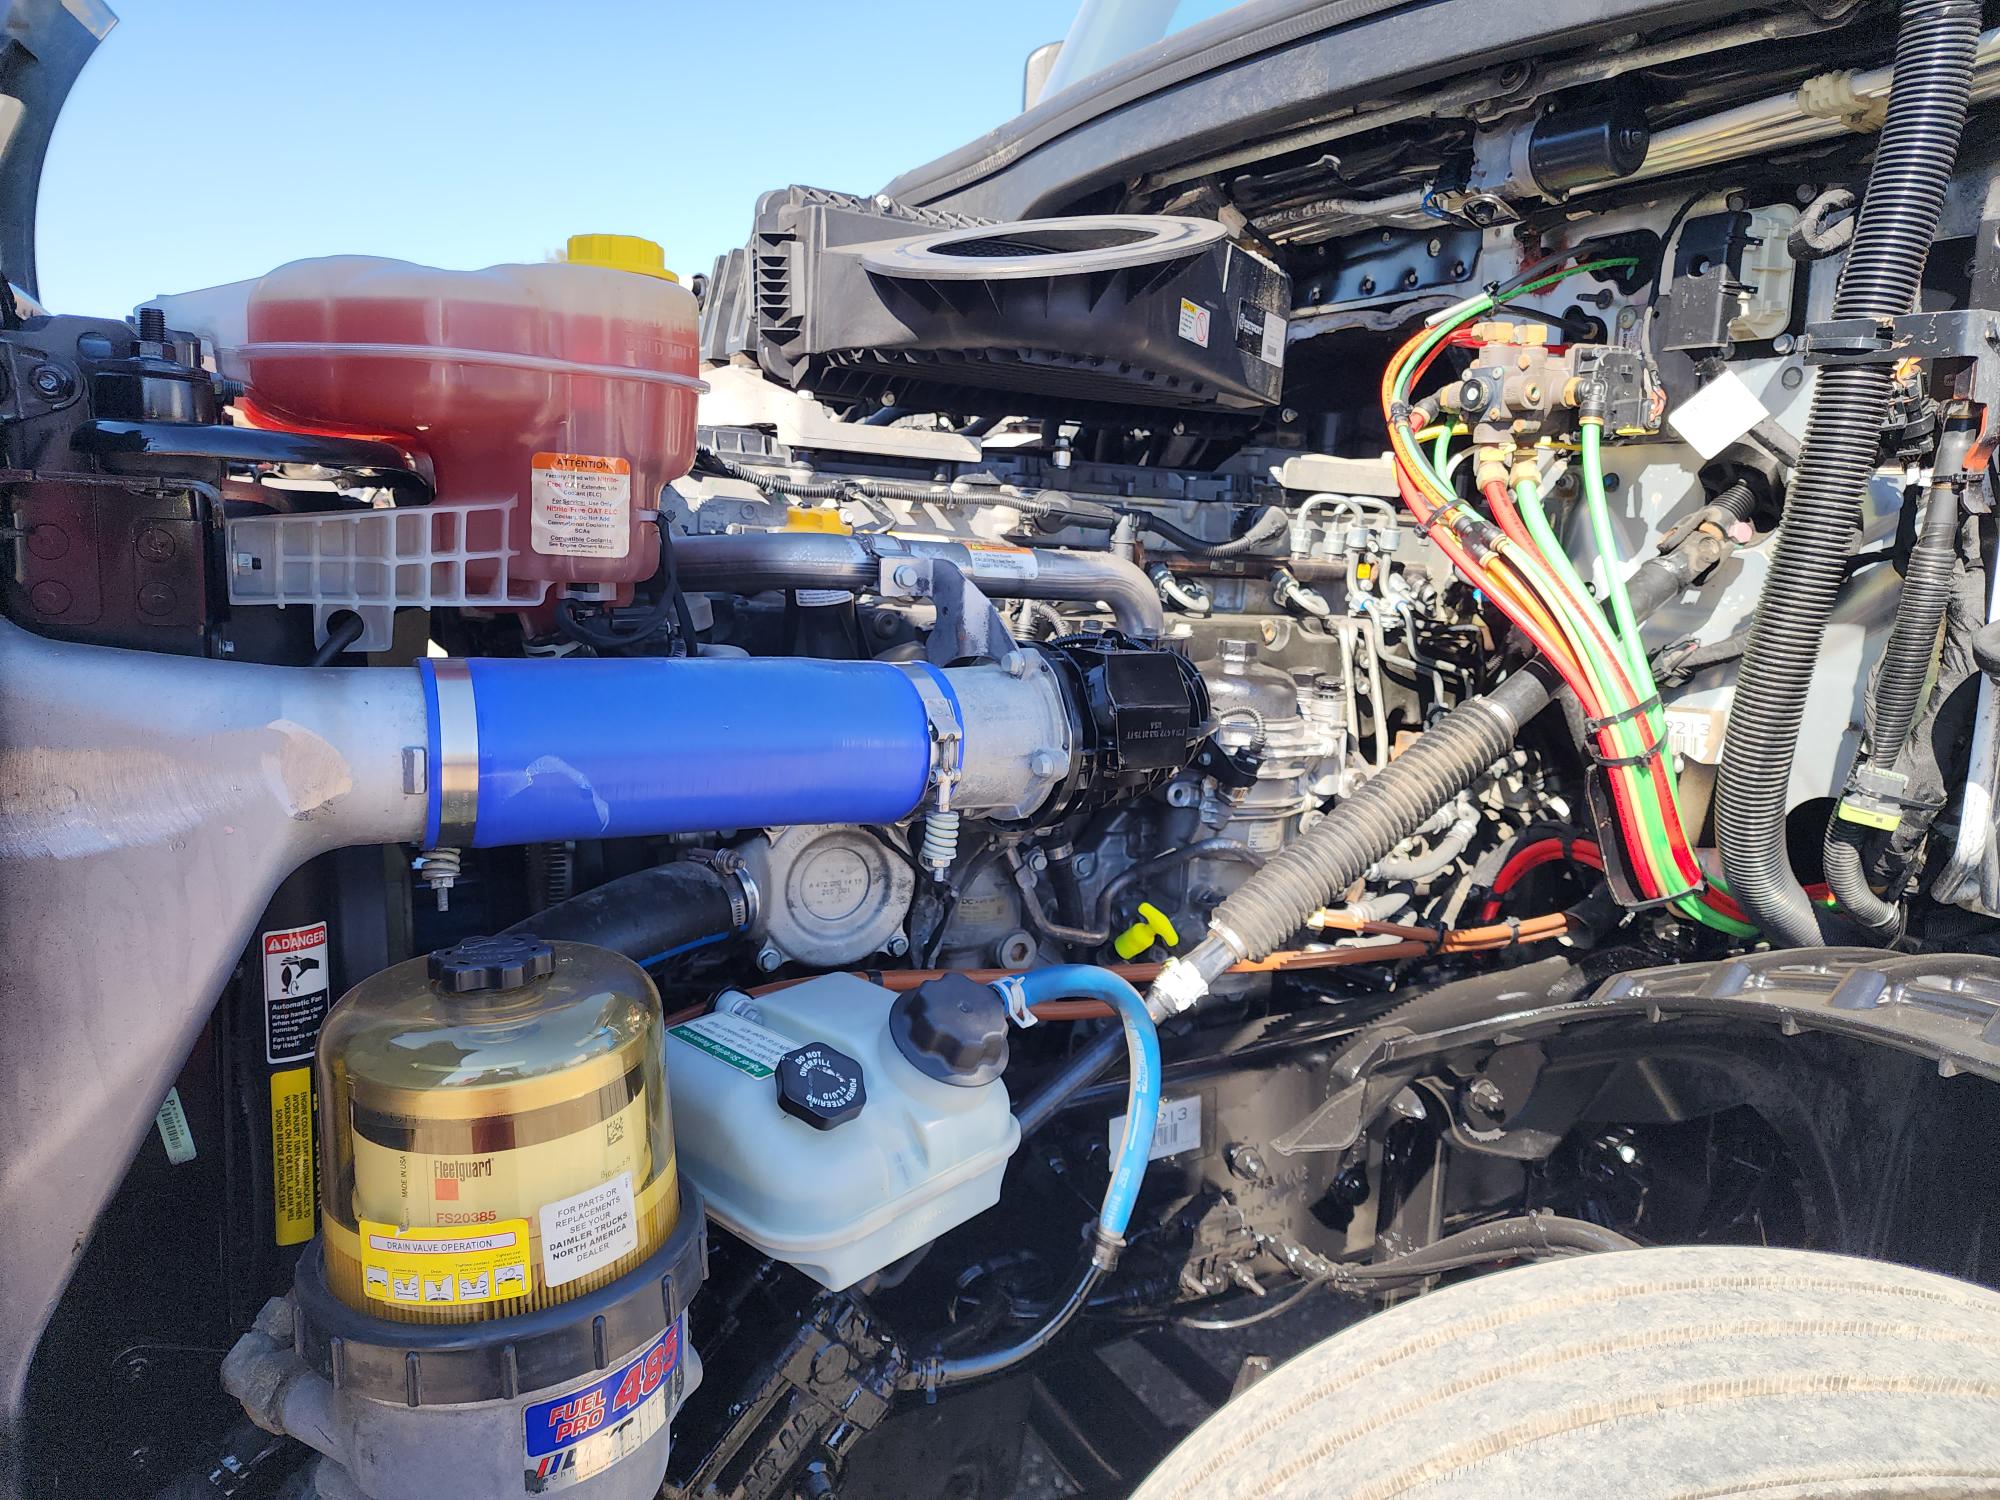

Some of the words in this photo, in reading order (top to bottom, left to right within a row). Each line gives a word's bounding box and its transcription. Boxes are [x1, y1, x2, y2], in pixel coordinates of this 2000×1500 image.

[557, 459, 609, 469] ATTENTION
[282, 930, 325, 950] DANGER
[272, 999, 310, 1011] Automatic
[311, 995, 322, 1004] Fan
[290, 1009, 310, 1018] hands
[310, 1004, 324, 1014] clear
[291, 1014, 312, 1025] engine
[286, 1033, 306, 1041] starts
[739, 1059, 764, 1073] Power
[794, 1055, 806, 1065] DO
[805, 1051, 822, 1059] NOT
[799, 1058, 831, 1077] OVERFILL
[822, 1086, 847, 1100] FLUID
[843, 1078, 857, 1101] POWER
[806, 1094, 846, 1108] STEERING
[285, 1129, 292, 1139] ON
[400, 1170, 408, 1178] IN
[434, 1158, 492, 1182] Fleetguard
[400, 1179, 408, 1199] MADE
[555, 1196, 621, 1229] REPLACEMENTS
[557, 1205, 576, 1219] FOR
[578, 1193, 605, 1211] PARTS
[606, 1187, 617, 1198] OR
[436, 1210, 496, 1224] FS20385
[570, 1223, 587, 1234] SEE
[589, 1211, 611, 1226] YOUR
[549, 1230, 592, 1251] DAIMLER
[594, 1211, 628, 1233] TRUCKS
[386, 1241, 411, 1251] DRAIN
[412, 1243, 438, 1252] VALVE
[441, 1240, 492, 1251] OPERATION
[552, 1241, 587, 1261] NORTH
[589, 1223, 627, 1246] AMERICA
[576, 1242, 609, 1262] DEALER
[612, 1323, 679, 1413] 485
[549, 1388, 607, 1428] FUEL
[555, 1407, 605, 1443] PRO
